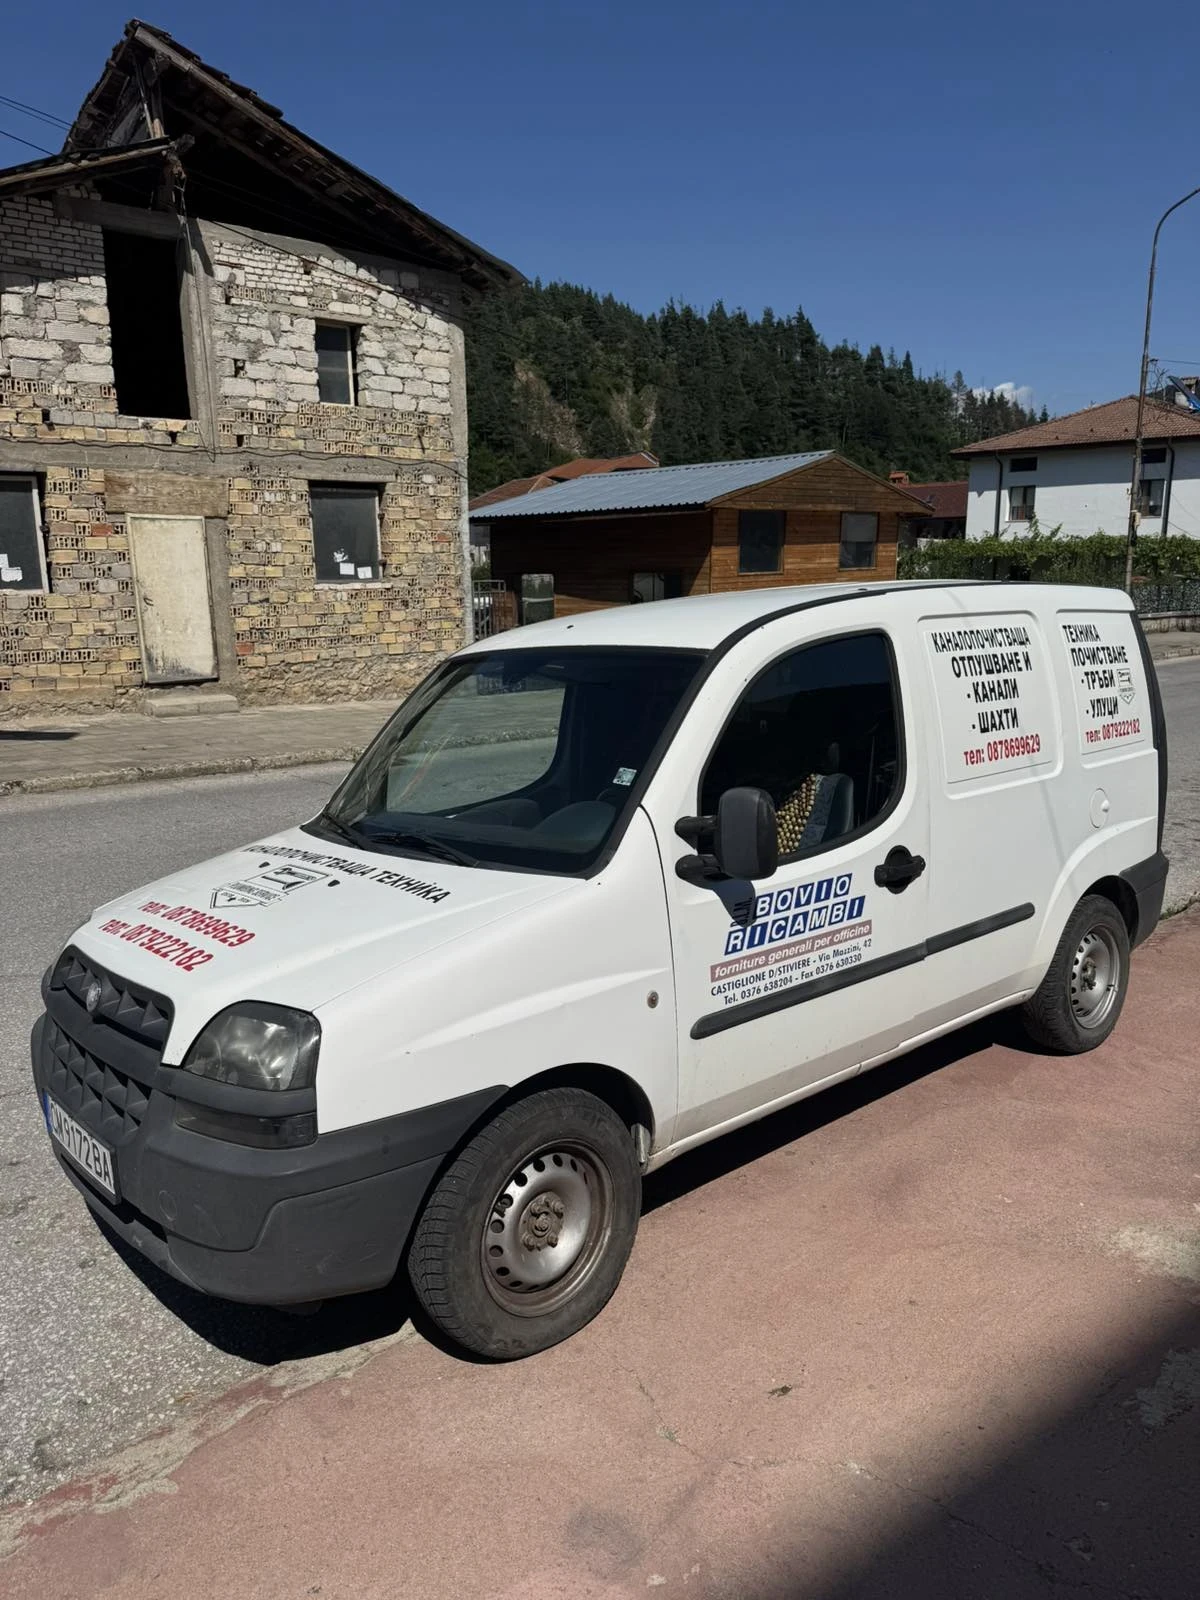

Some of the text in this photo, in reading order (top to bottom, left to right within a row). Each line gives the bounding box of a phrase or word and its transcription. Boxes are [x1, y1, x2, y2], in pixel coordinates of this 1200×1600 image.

[931, 627, 1031, 653] КАНАЛОПОЧИСТВАЩА
[1062, 624, 1101, 643] ТЕХНИКА
[951, 651, 1032, 678] ОТПУШВАНЕ И
[1070, 646, 1128, 667] ПОЧИСТВАНЕ
[1102, 718, 1141, 740] 0879222182
[963, 733, 1041, 766] тел: 0878699629
[369, 870, 451, 903] ТЕХНИКА
[756, 874, 851, 917] BOVIO
[161, 906, 255, 947] 0878699629
[727, 898, 862, 953] RICAMBI
[120, 924, 214, 972] 0879222182
[714, 924, 869, 978] forniture generali per officine
[711, 973, 766, 996] CASTIGLIONE
[768, 957, 810, 979] D/STIVIERE
[818, 953, 830, 962] Via
[863, 938, 872, 948] 42
[724, 992, 738, 1005] Tel.
[741, 987, 761, 999] 0376
[763, 976, 793, 994] 638204
[801, 971, 813, 981] Fax
[815, 962, 834, 975] 0376
[835, 953, 862, 969] 630330
